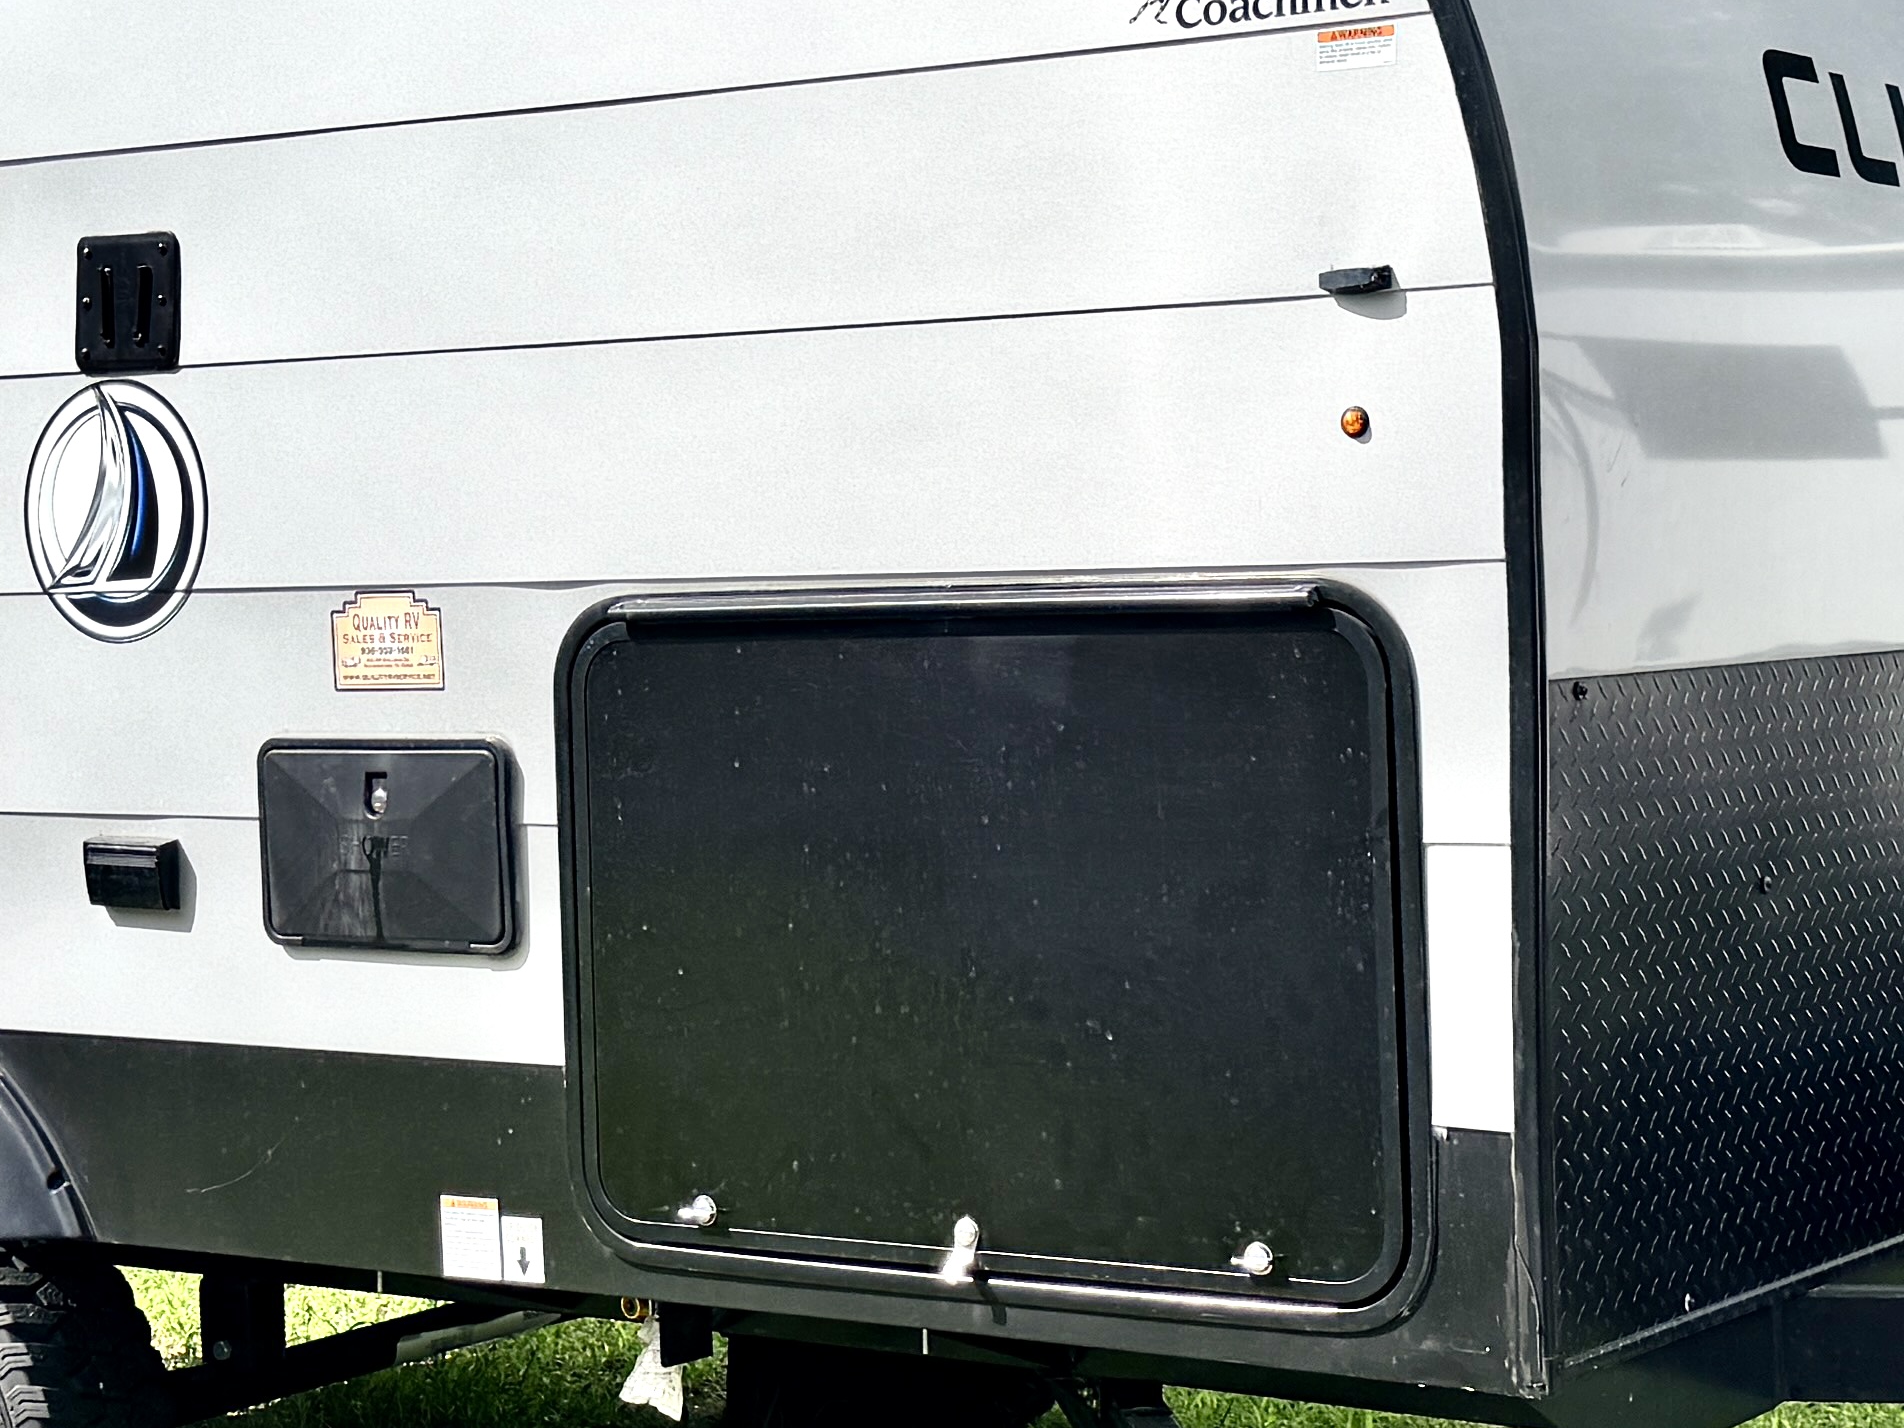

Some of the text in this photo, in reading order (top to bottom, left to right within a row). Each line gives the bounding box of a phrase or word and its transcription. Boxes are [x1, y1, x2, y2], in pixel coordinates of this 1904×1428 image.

[352, 612, 420, 632] QUALITY RV
[342, 633, 375, 644] SALES
[389, 632, 433, 644] SERVICE
[339, 834, 409, 859] SHOWER
